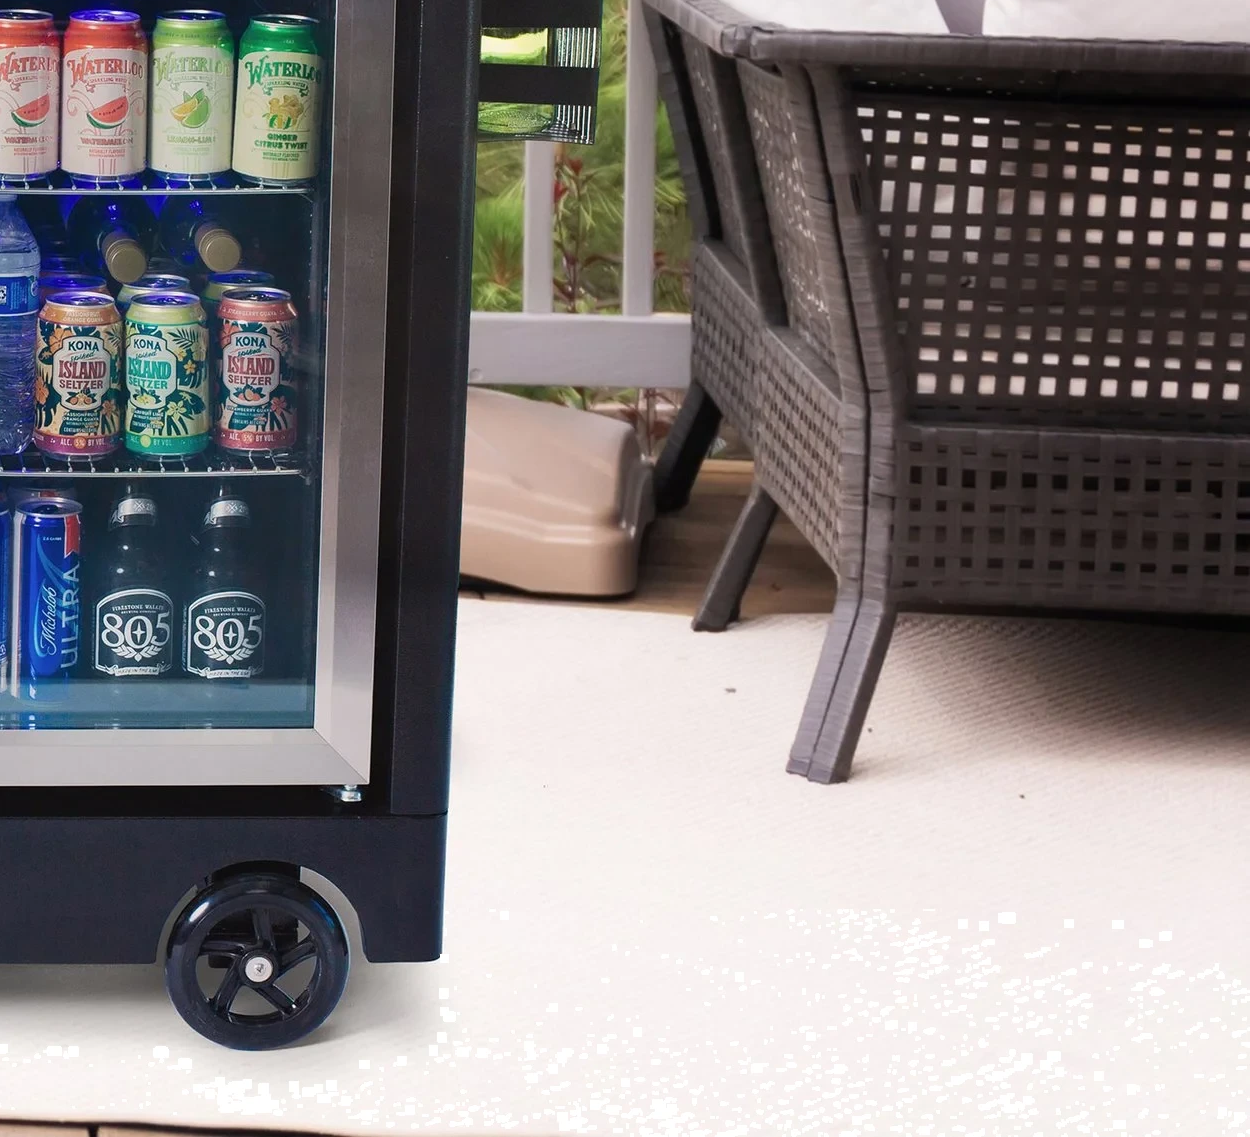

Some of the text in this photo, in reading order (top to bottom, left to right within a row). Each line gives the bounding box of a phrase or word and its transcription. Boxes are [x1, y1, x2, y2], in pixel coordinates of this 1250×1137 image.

[67, 52, 143, 88] WATERLOO
[81, 137, 133, 145] WATERMELON
[267, 133, 298, 141] GINGER
[254, 140, 308, 150] CITRUS TWIST
[68, 341, 99, 351] KONA
[134, 339, 162, 351] KONA
[236, 336, 267, 348] KONA
[58, 360, 106, 379] ISLAND
[128, 356, 172, 379] ISLAND
[227, 355, 275, 375] ISLAND
[59, 379, 103, 390] SELTZER
[129, 378, 168, 390] SELTZER
[228, 374, 272, 385] SELTZER
[60, 438, 72, 446] ALC.
[87, 438, 95, 446] BY
[229, 433, 240, 441] ALC.
[243, 434, 253, 442] 5%
[256, 434, 263, 442] BY
[40, 585, 57, 656] Michelob
[60, 561, 80, 669] ULTRA
[101, 611, 170, 650] 805
[193, 613, 262, 652] 805
